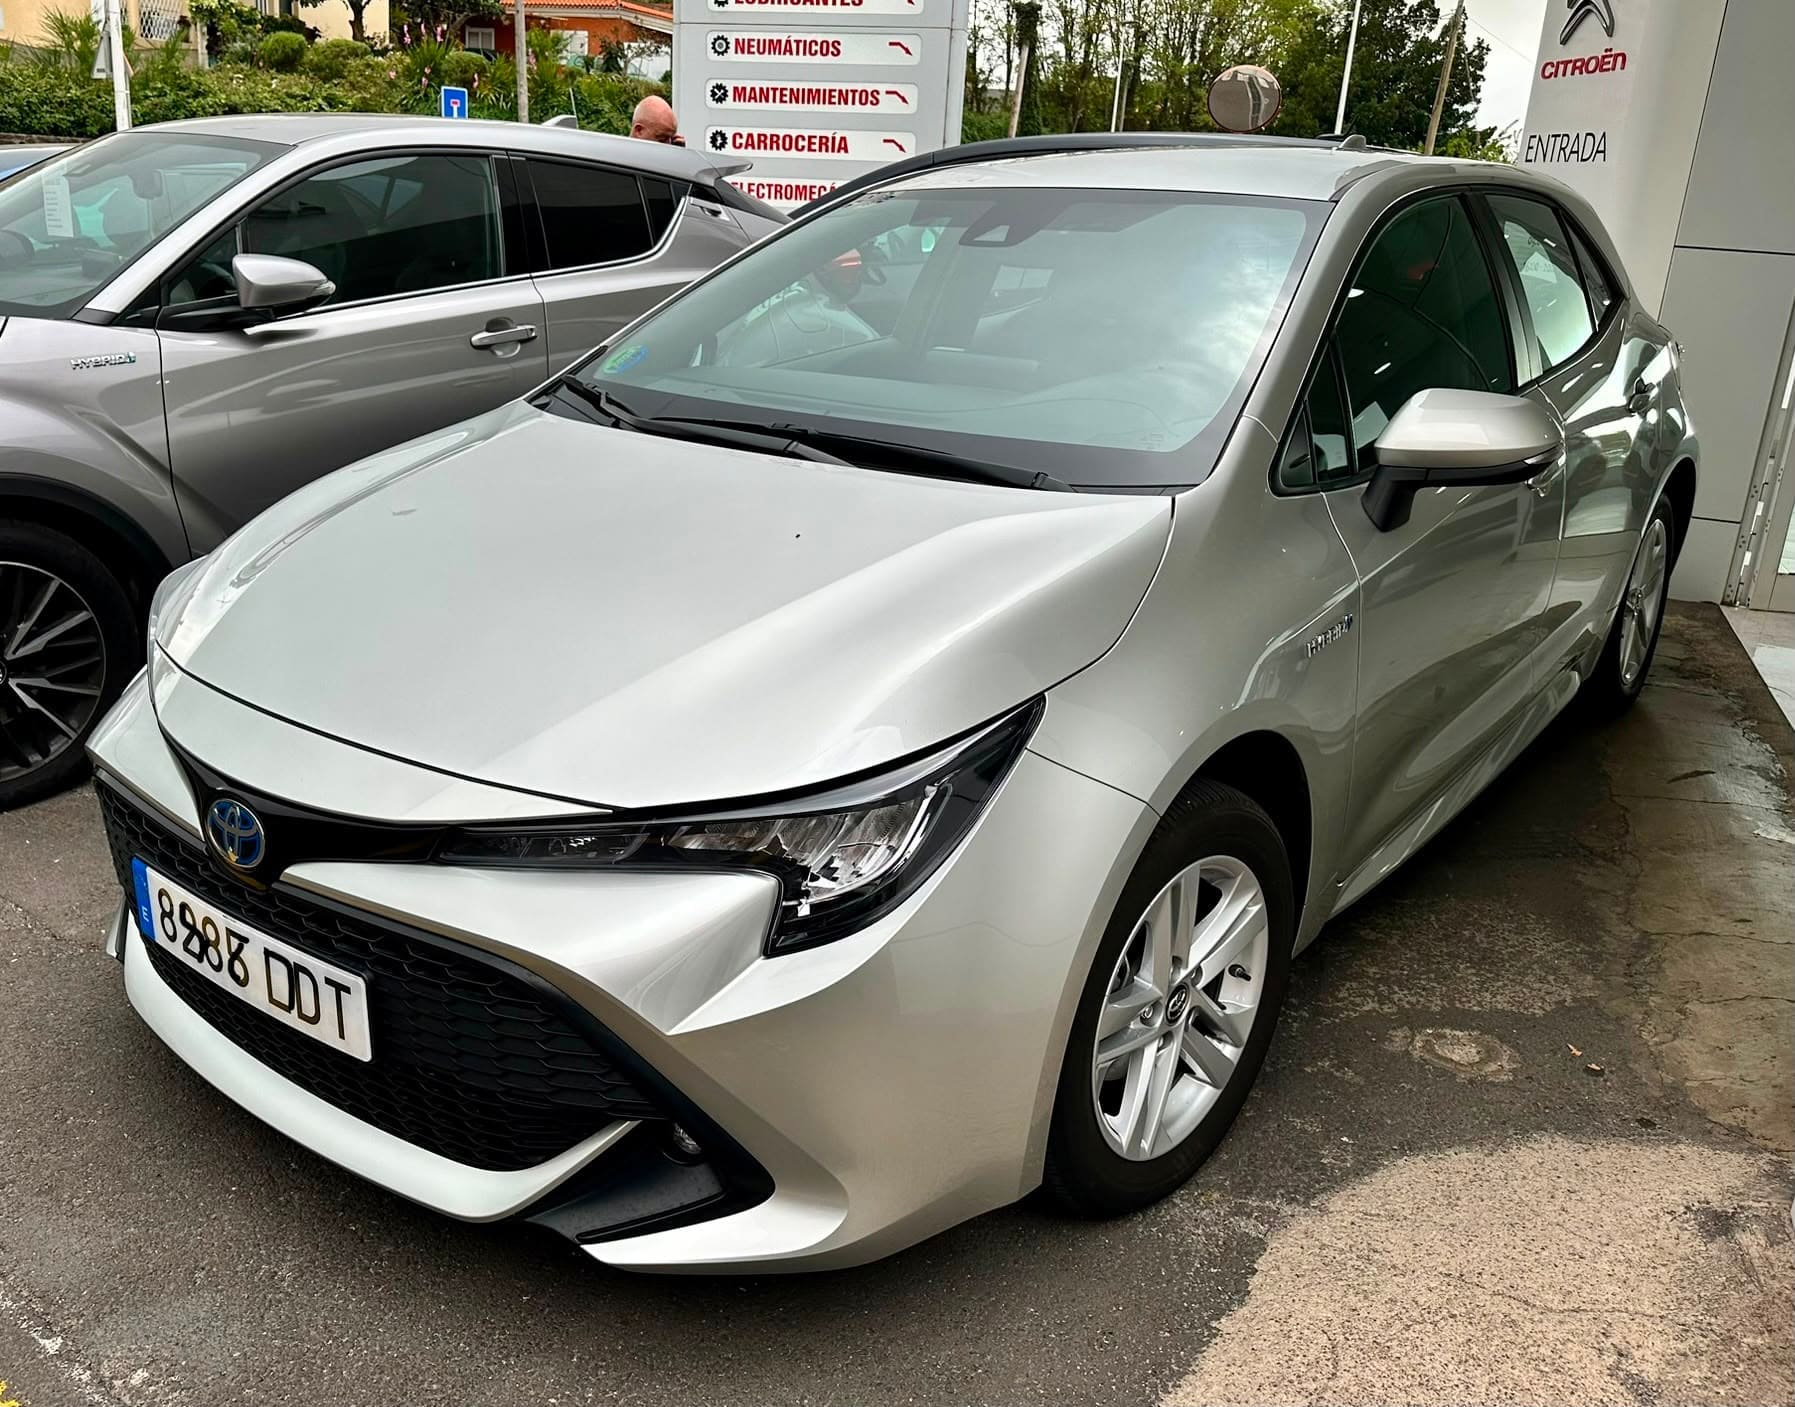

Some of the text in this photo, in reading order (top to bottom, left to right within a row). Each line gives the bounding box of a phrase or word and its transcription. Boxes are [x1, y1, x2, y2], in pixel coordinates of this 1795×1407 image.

[734, 36, 842, 57] NEUMÁTICOS
[732, 86, 880, 106] MANTENIMIENTOS
[732, 132, 849, 154] CARROCERÍA
[1525, 131, 1607, 163] ENTRADA
